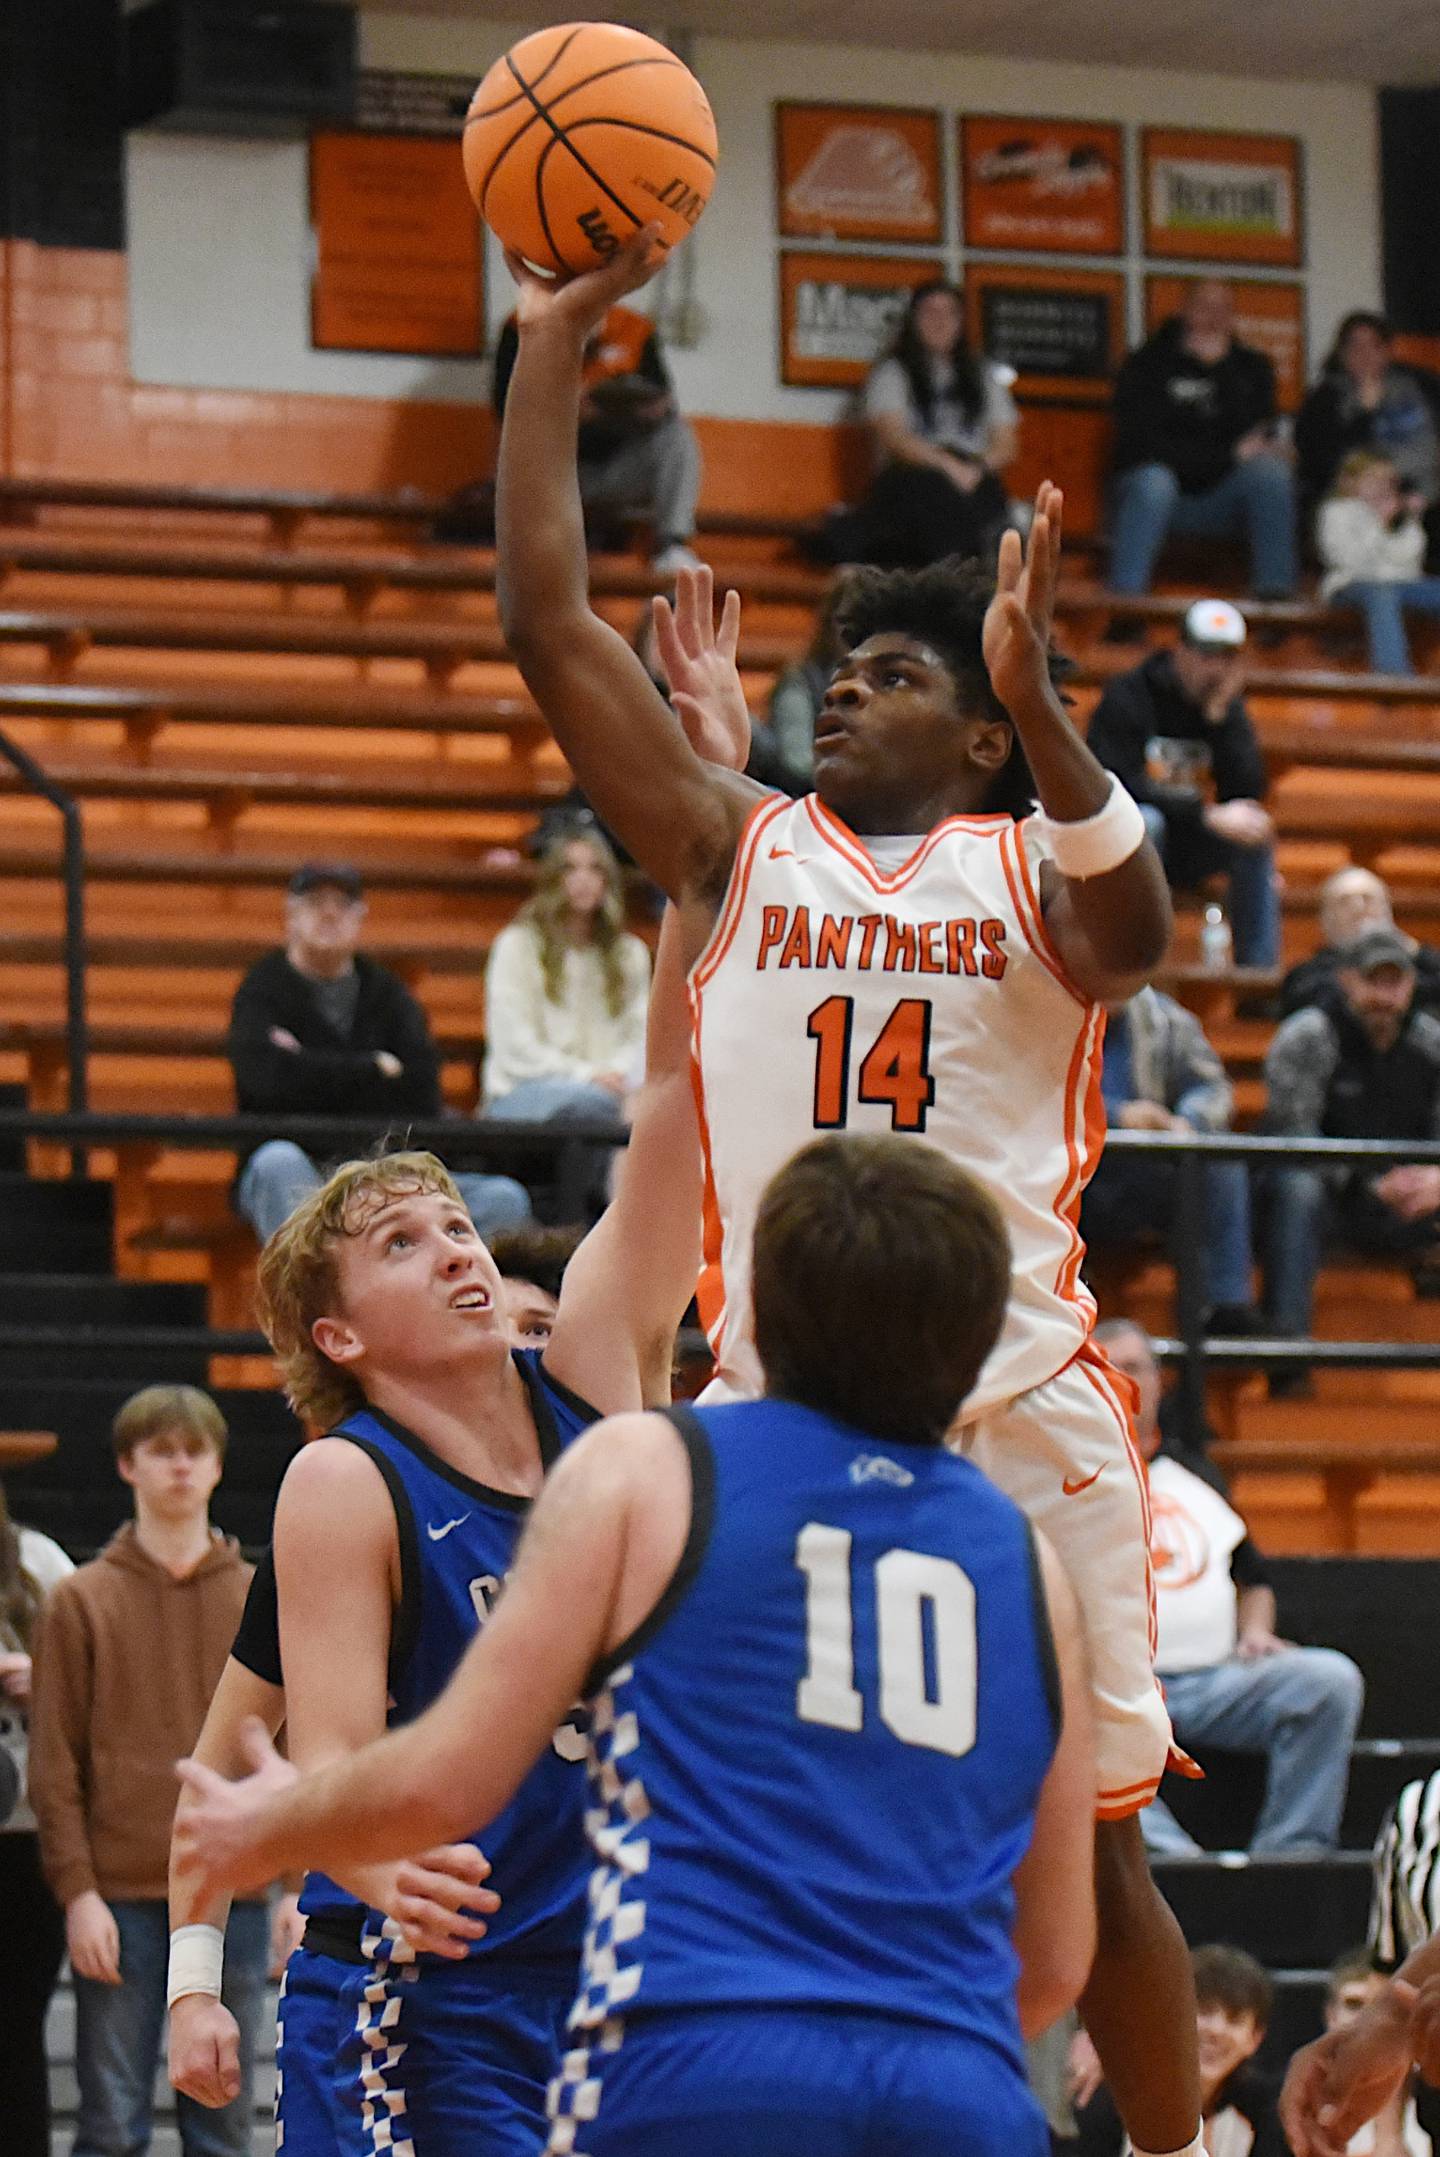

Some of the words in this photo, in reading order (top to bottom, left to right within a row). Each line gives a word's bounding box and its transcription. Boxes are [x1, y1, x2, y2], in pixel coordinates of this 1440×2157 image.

[756, 904, 1009, 981] PANTHERS
[806, 995, 935, 1133] 14
[796, 1521, 977, 1759] 10
